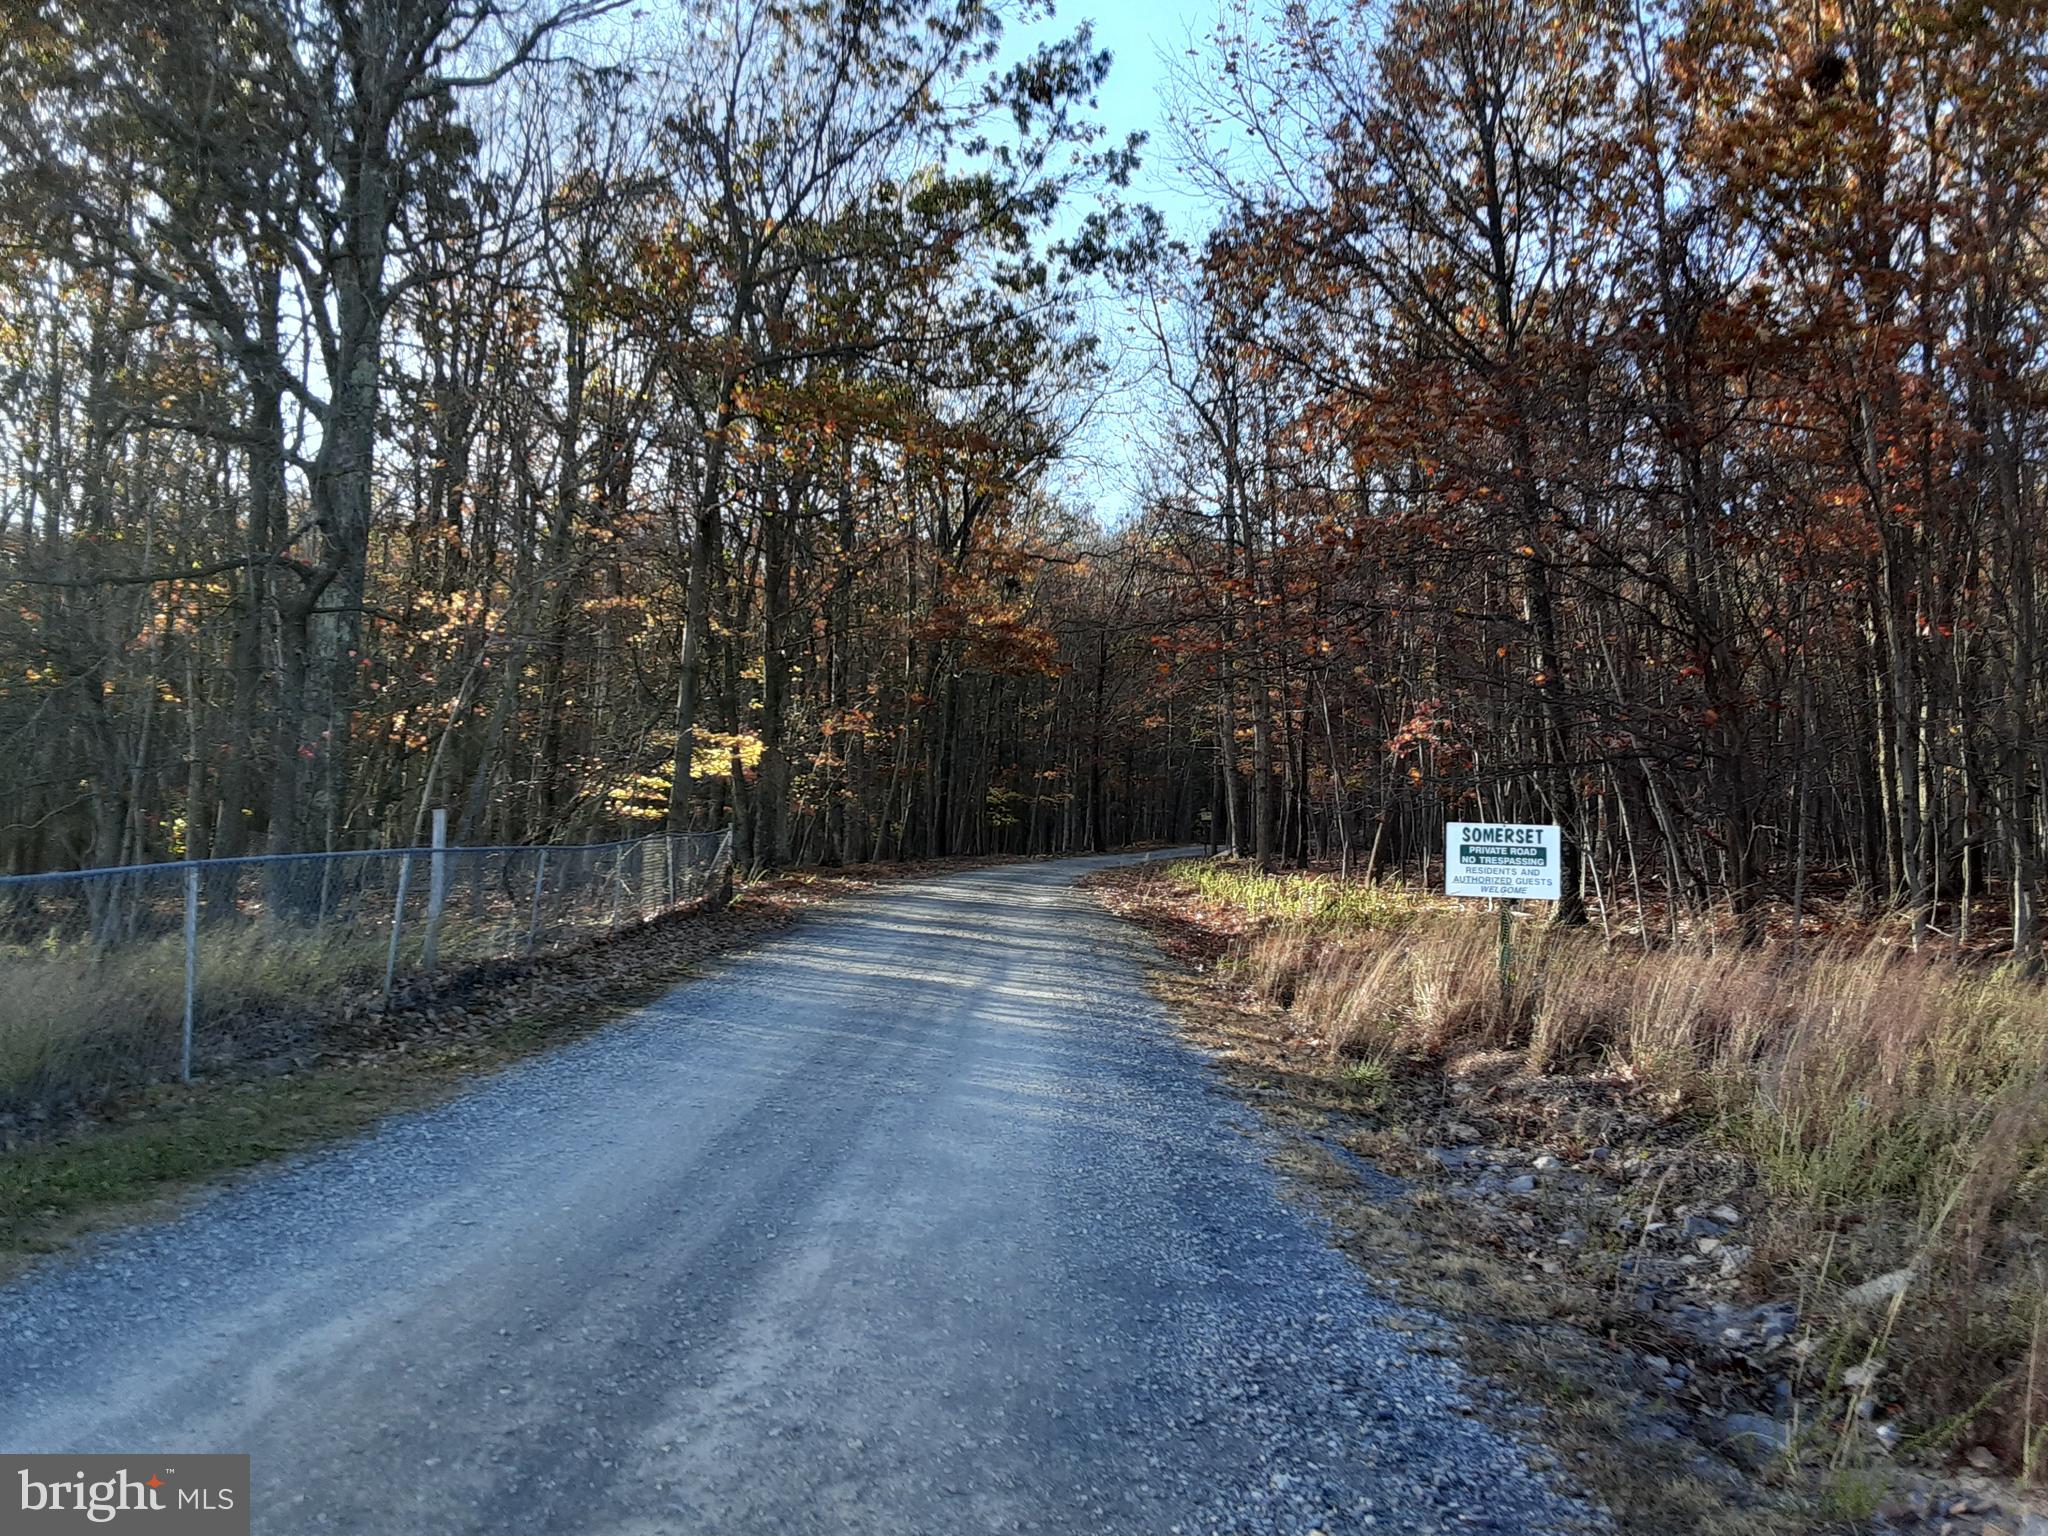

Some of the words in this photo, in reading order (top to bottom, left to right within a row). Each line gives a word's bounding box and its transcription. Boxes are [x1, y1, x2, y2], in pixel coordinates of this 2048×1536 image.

[1462, 827, 1544, 844] SOMERSET
[1469, 846, 1508, 855] PRIVATE
[1510, 847, 1537, 856] ROAD
[1462, 856, 1476, 864] NO
[1478, 856, 1545, 866] TRESPASSING
[1465, 866, 1517, 876] RESIDENTS
[1520, 868, 1540, 876] AND
[1453, 876, 1513, 885] AUTHORIZED
[1515, 877, 1553, 886] GUESTS
